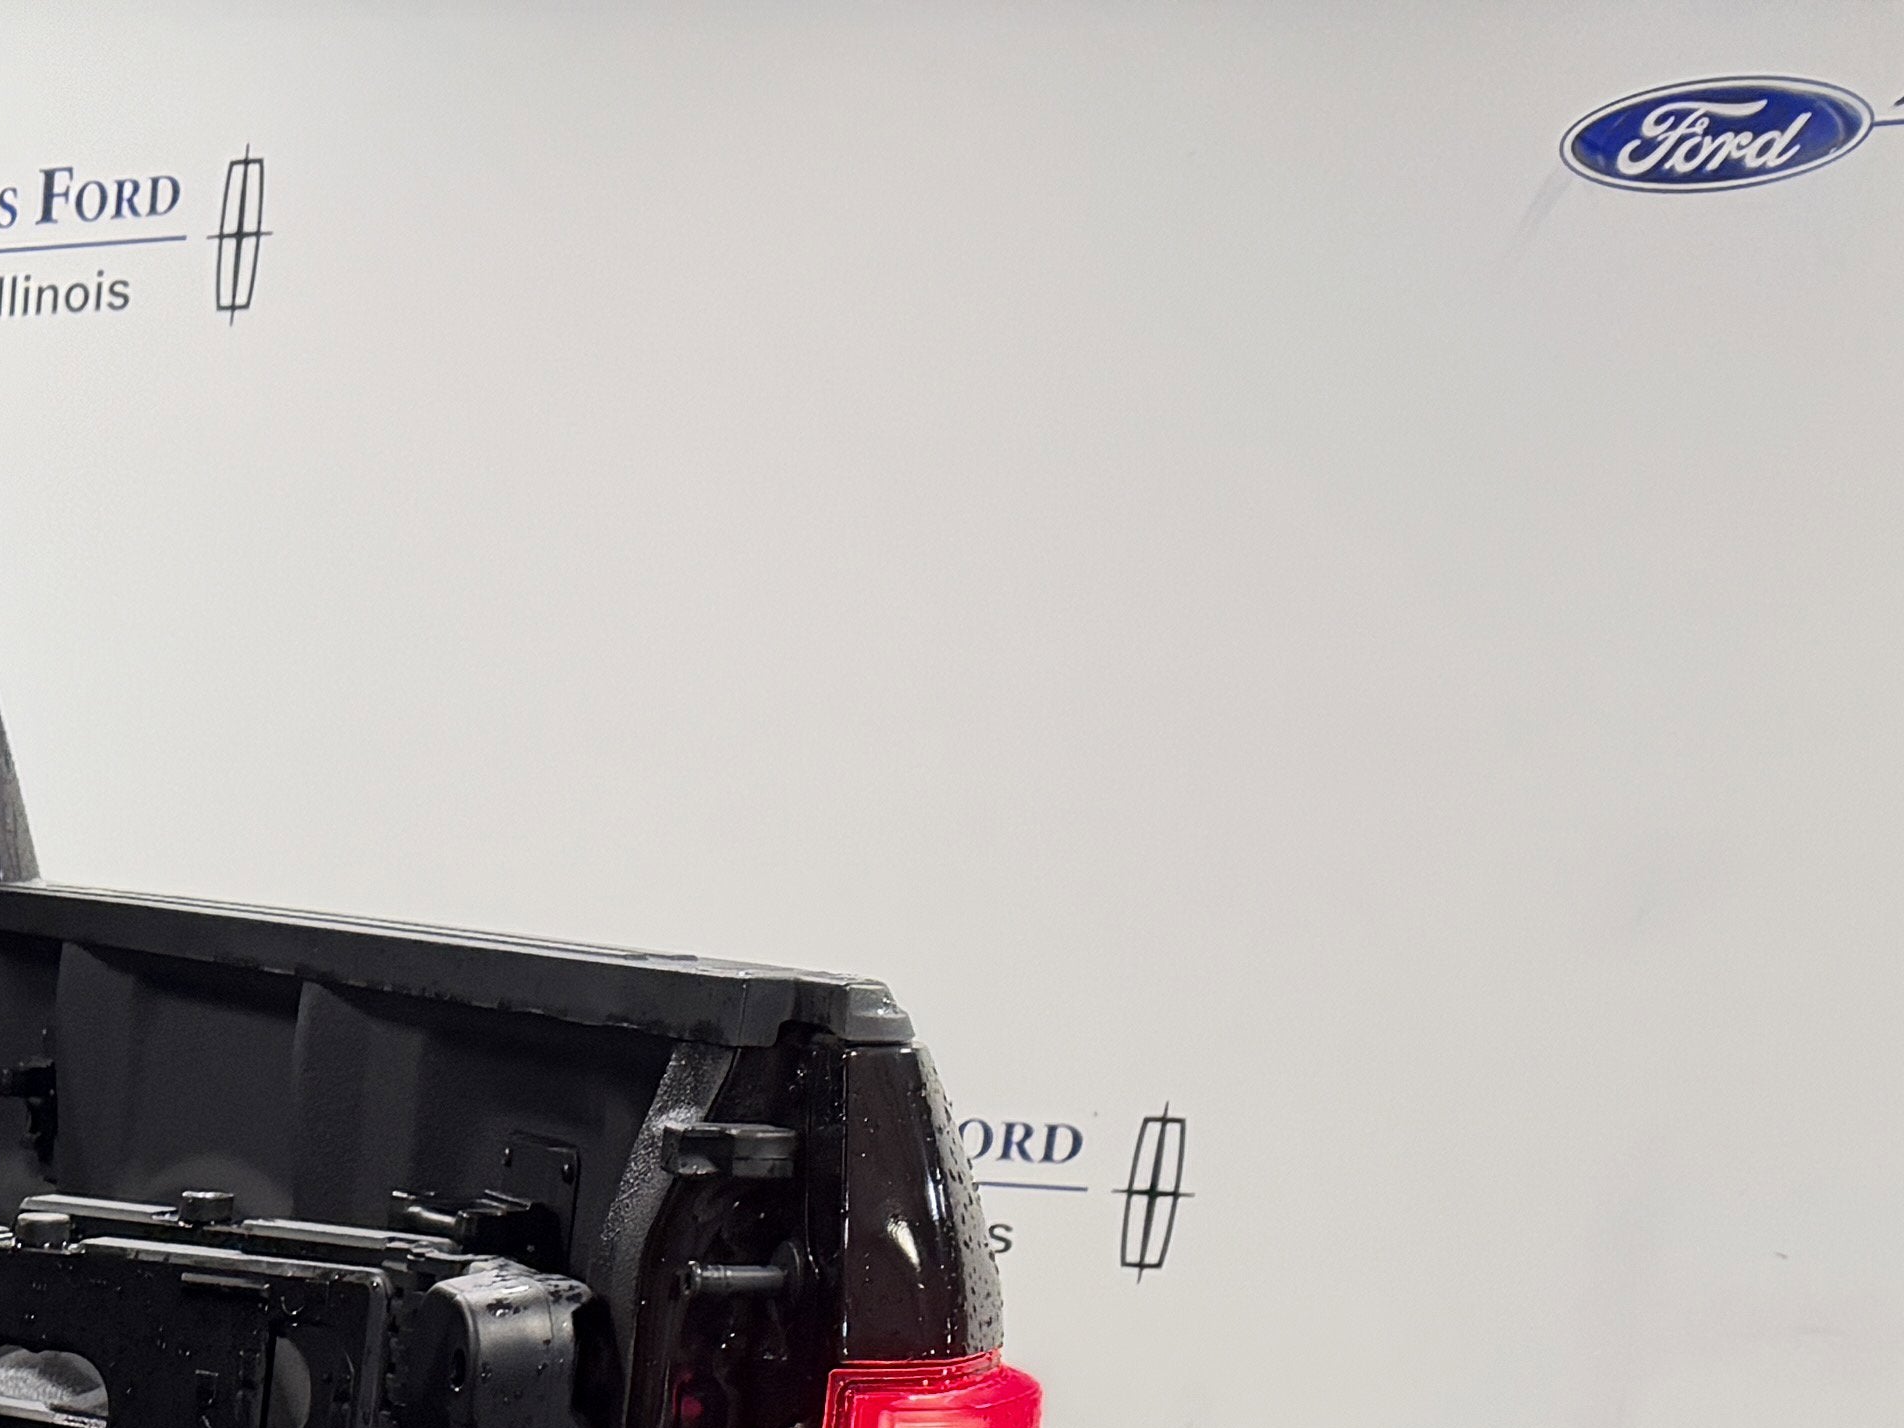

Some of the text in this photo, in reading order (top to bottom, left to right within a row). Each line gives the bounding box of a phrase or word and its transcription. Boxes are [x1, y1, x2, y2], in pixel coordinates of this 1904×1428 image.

[1616, 99, 1812, 175] Ford
[35, 167, 181, 225] FORD
[958, 1119, 1084, 1164] ORD
